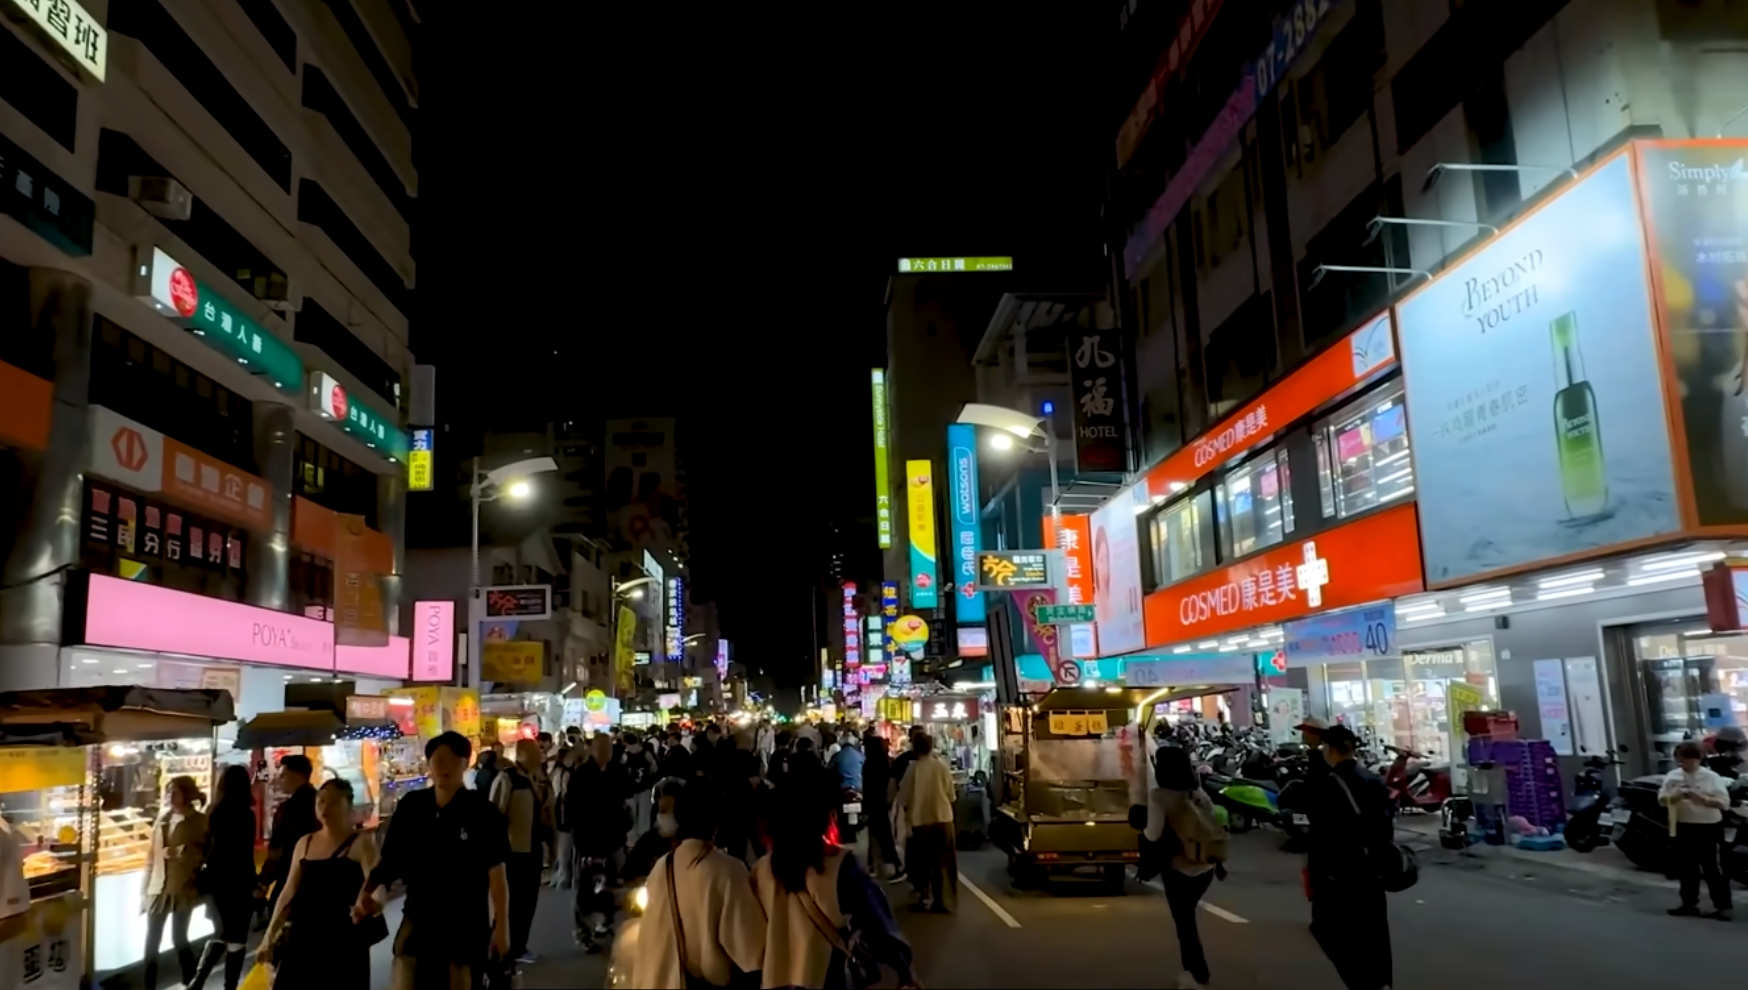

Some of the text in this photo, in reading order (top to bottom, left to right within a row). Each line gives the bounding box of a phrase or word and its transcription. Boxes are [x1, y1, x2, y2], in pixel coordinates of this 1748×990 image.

[1462, 249, 1543, 318] BEYOND
[1477, 284, 1539, 334] YOUTH
[1080, 426, 1119, 438] HOTEL
[1195, 428, 1235, 468] COSMED
[959, 457, 973, 515] watsons
[1180, 562, 1296, 625] COSMED 康是美
[1366, 622, 1388, 655] 40
